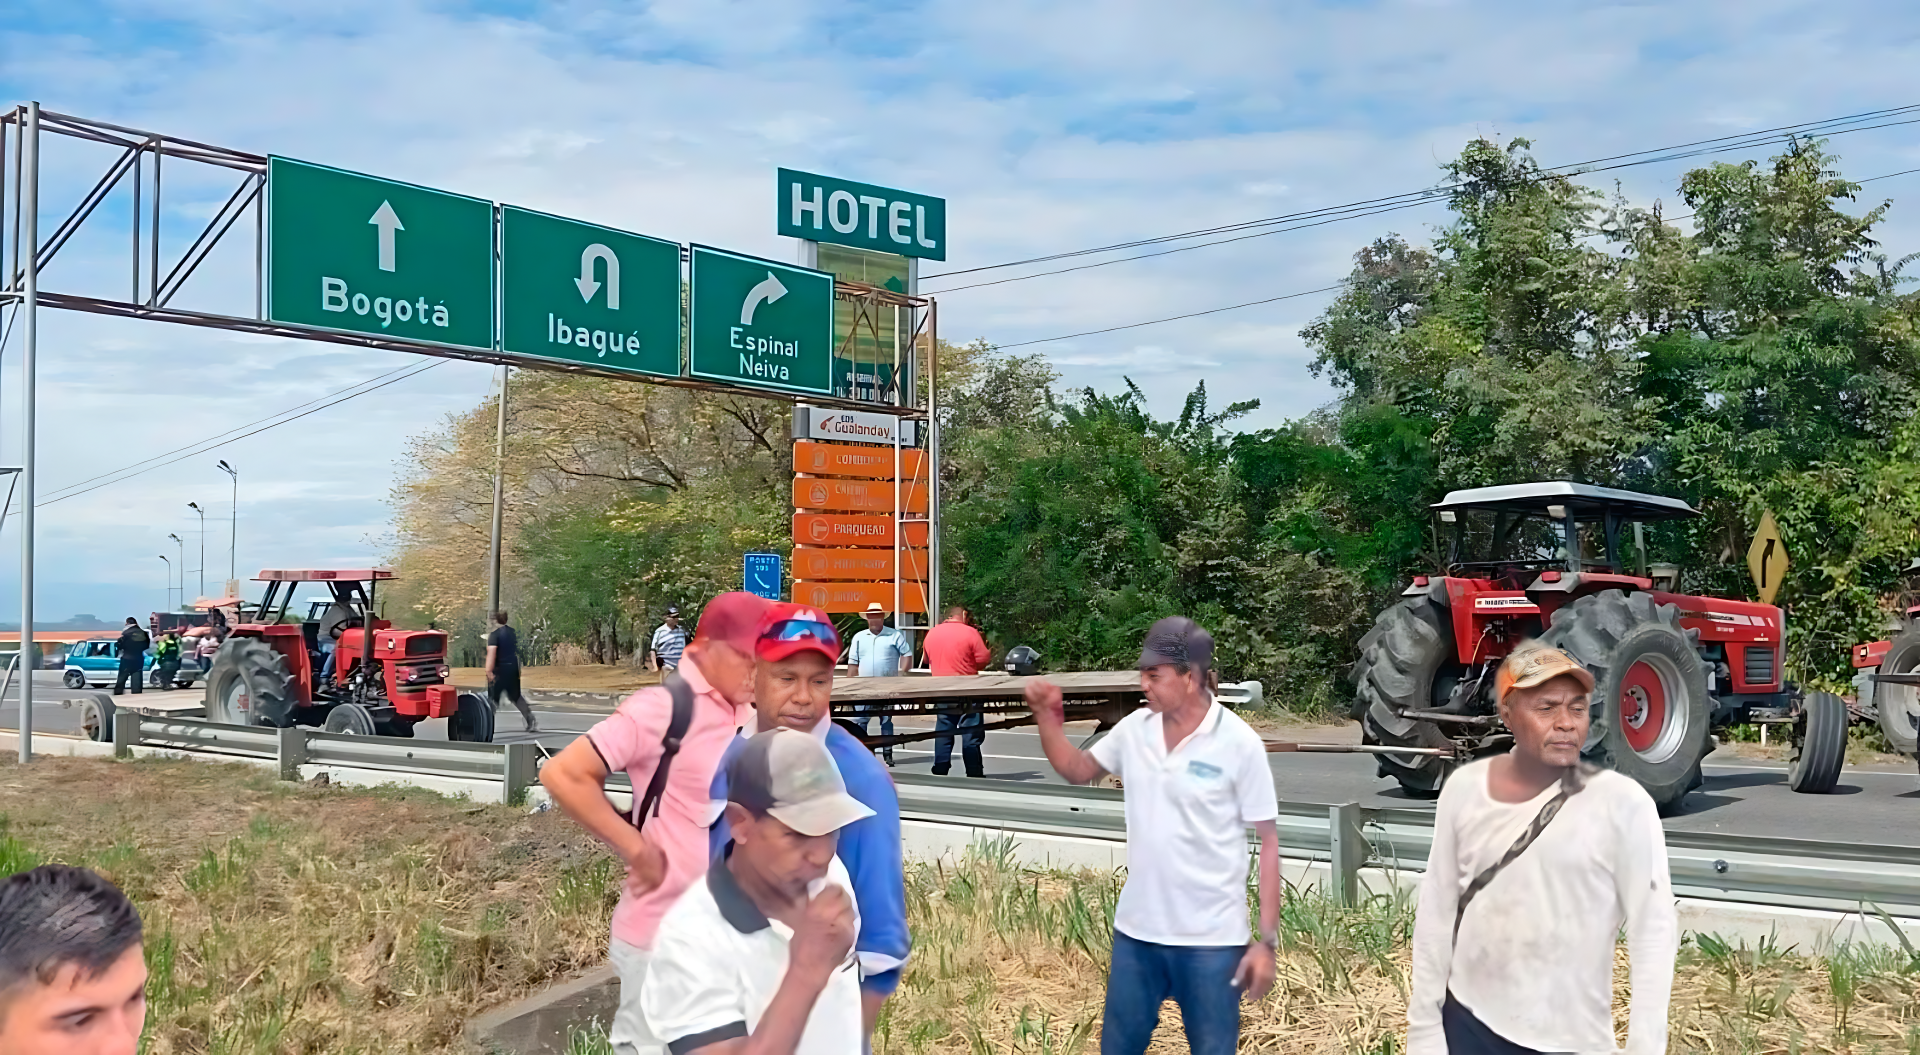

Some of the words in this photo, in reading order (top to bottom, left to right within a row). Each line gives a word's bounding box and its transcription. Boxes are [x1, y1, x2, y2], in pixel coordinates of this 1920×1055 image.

[791, 182, 936, 249] HOTEL
[322, 276, 449, 329] Bogotá
[548, 312, 640, 358] Ibagué
[730, 326, 798, 358] Espinal
[740, 352, 789, 381] Neiva
[835, 421, 890, 439] Gualanday
